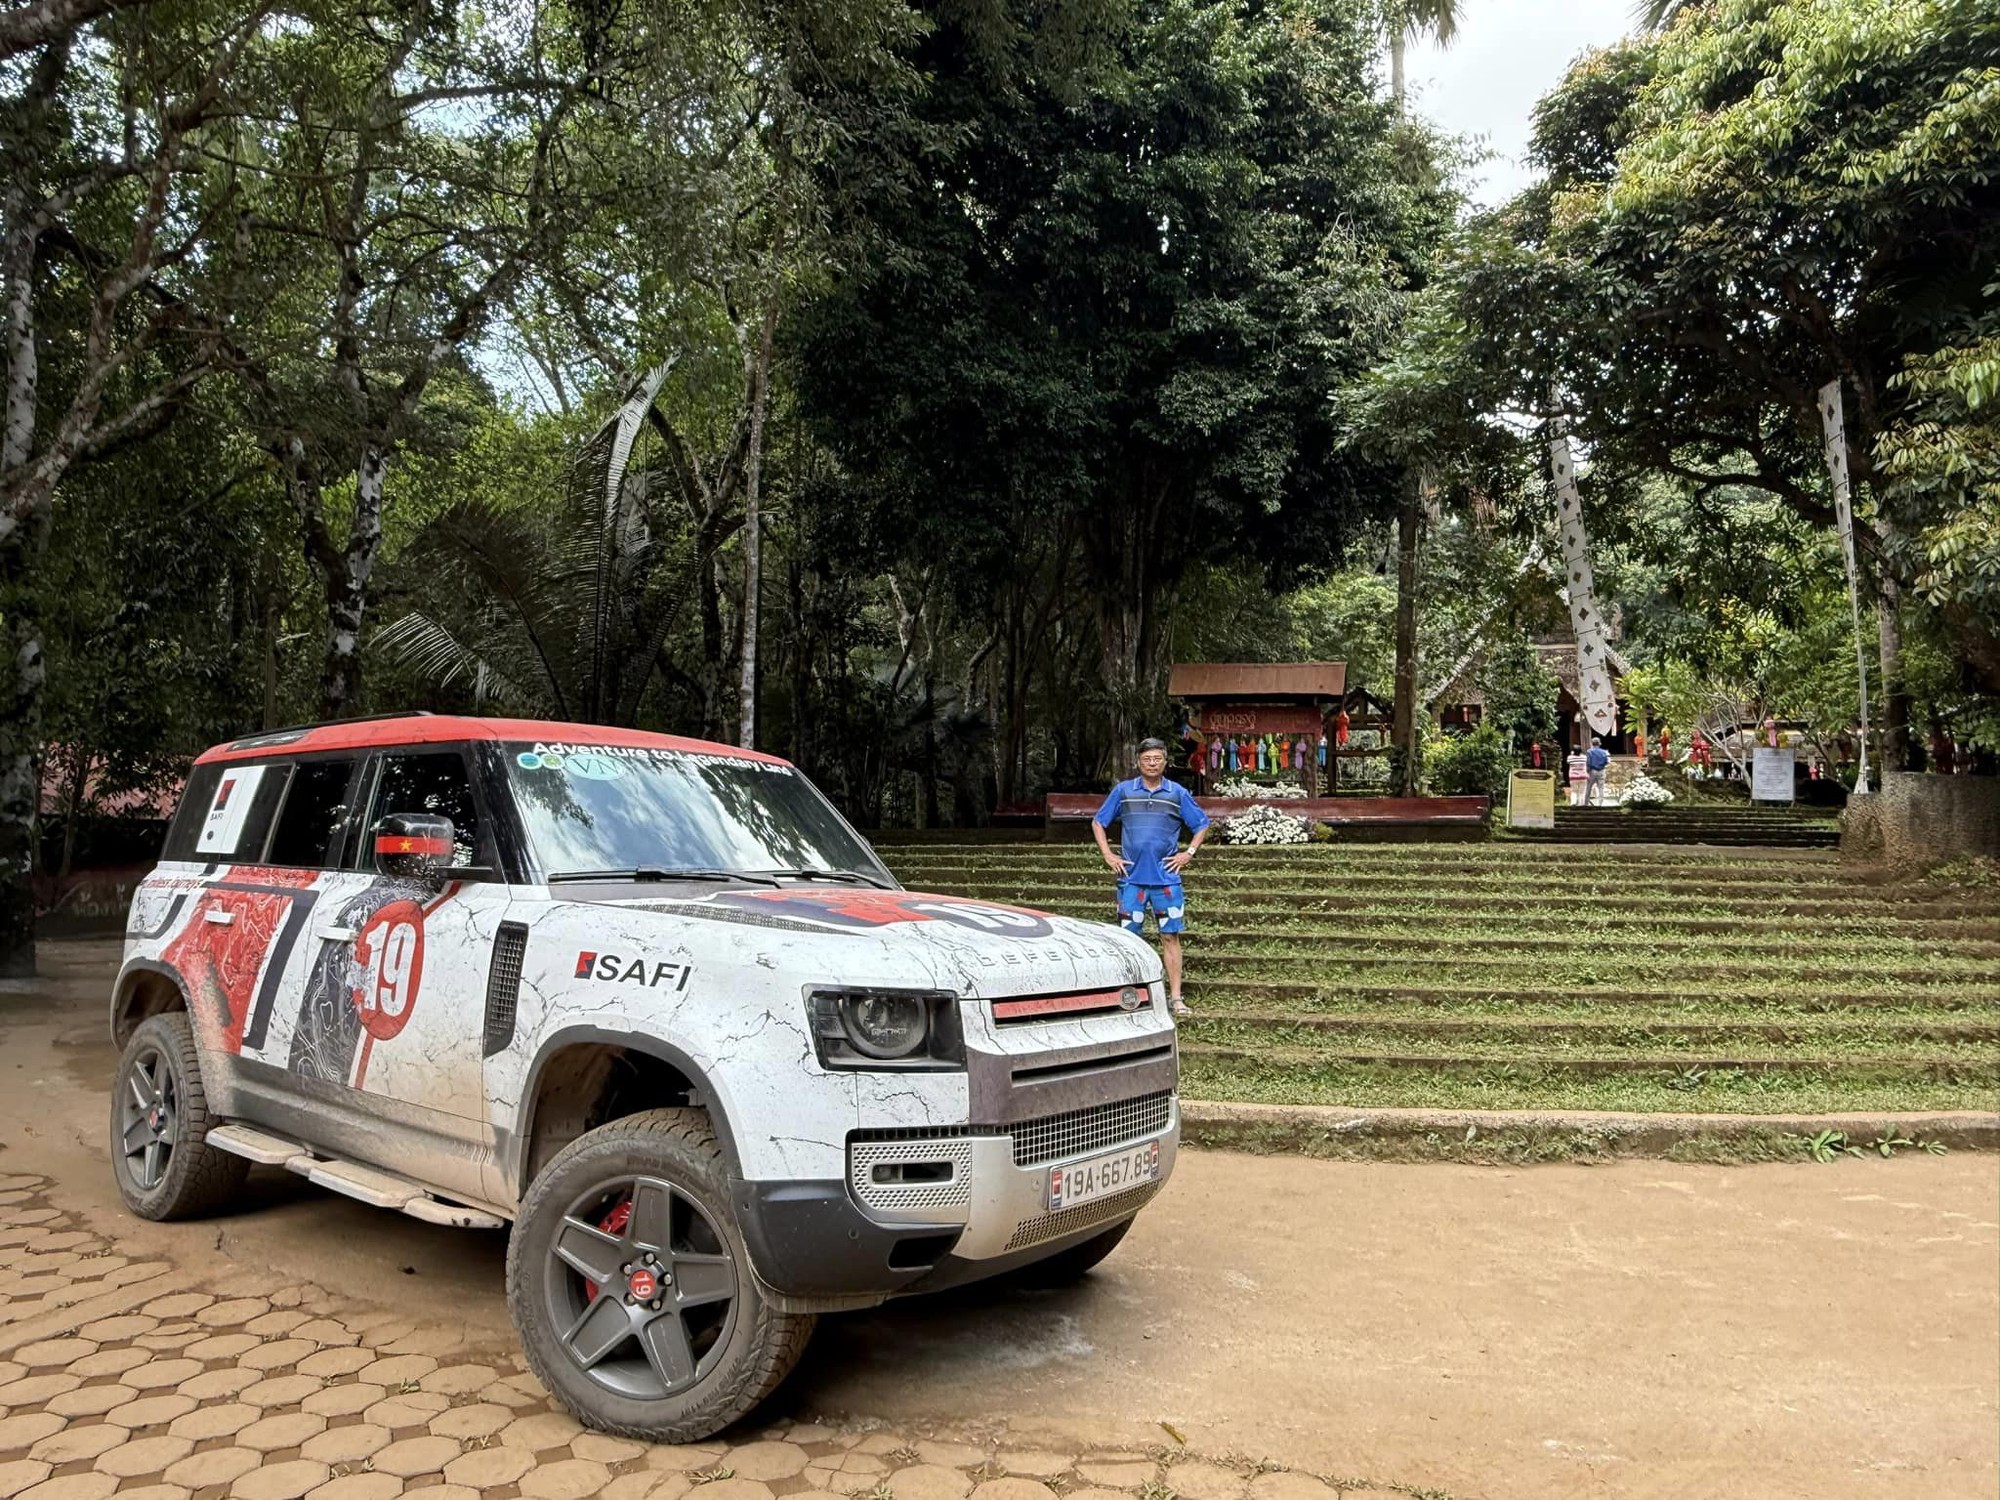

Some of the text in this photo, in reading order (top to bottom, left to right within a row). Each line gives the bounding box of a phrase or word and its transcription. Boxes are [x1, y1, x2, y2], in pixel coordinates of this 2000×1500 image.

[533, 742, 793, 776] Adventure to Legendary Land
[571, 758, 619, 775] VN
[210, 812, 224, 821] SAFI
[912, 903, 1039, 928] 19
[364, 920, 417, 1017] 19
[974, 946, 1136, 967] DEFENDER
[596, 954, 692, 991] SAFI
[1064, 1150, 1151, 1199] 19A-667.89
[634, 1273, 652, 1295] 19
